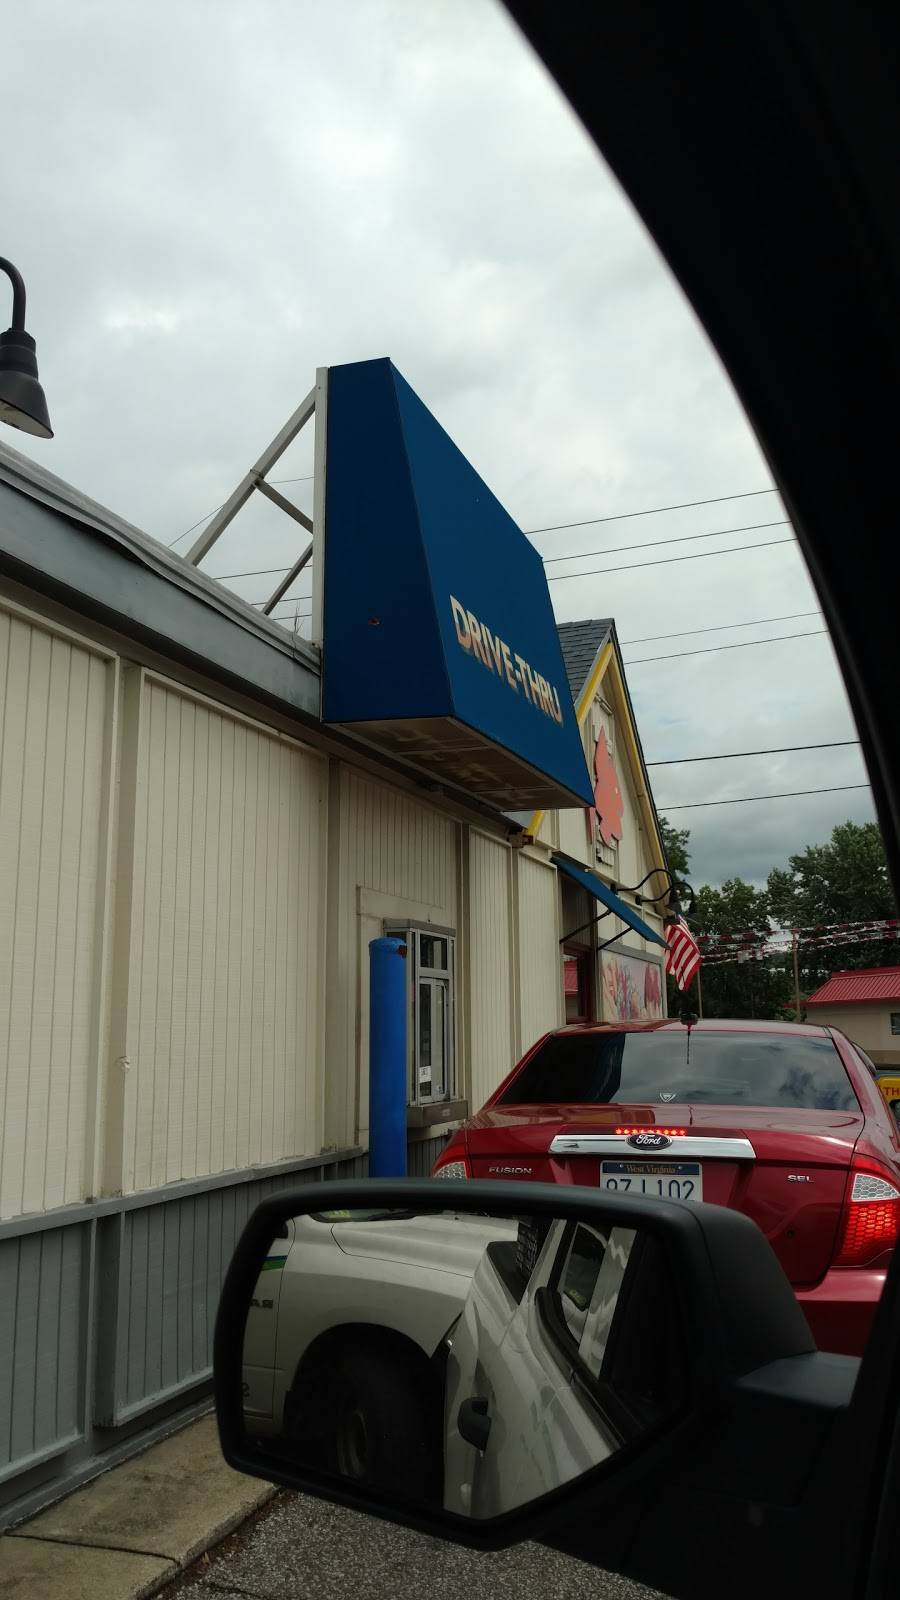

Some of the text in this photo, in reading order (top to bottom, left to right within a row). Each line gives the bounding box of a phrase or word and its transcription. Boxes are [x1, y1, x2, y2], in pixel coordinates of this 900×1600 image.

[449, 594, 562, 723] DRIVE-THRU
[636, 1134, 662, 1145] Ford
[488, 1166, 532, 1175] FUSION
[626, 1164, 645, 1173] West
[787, 1174, 815, 1183] SEL
